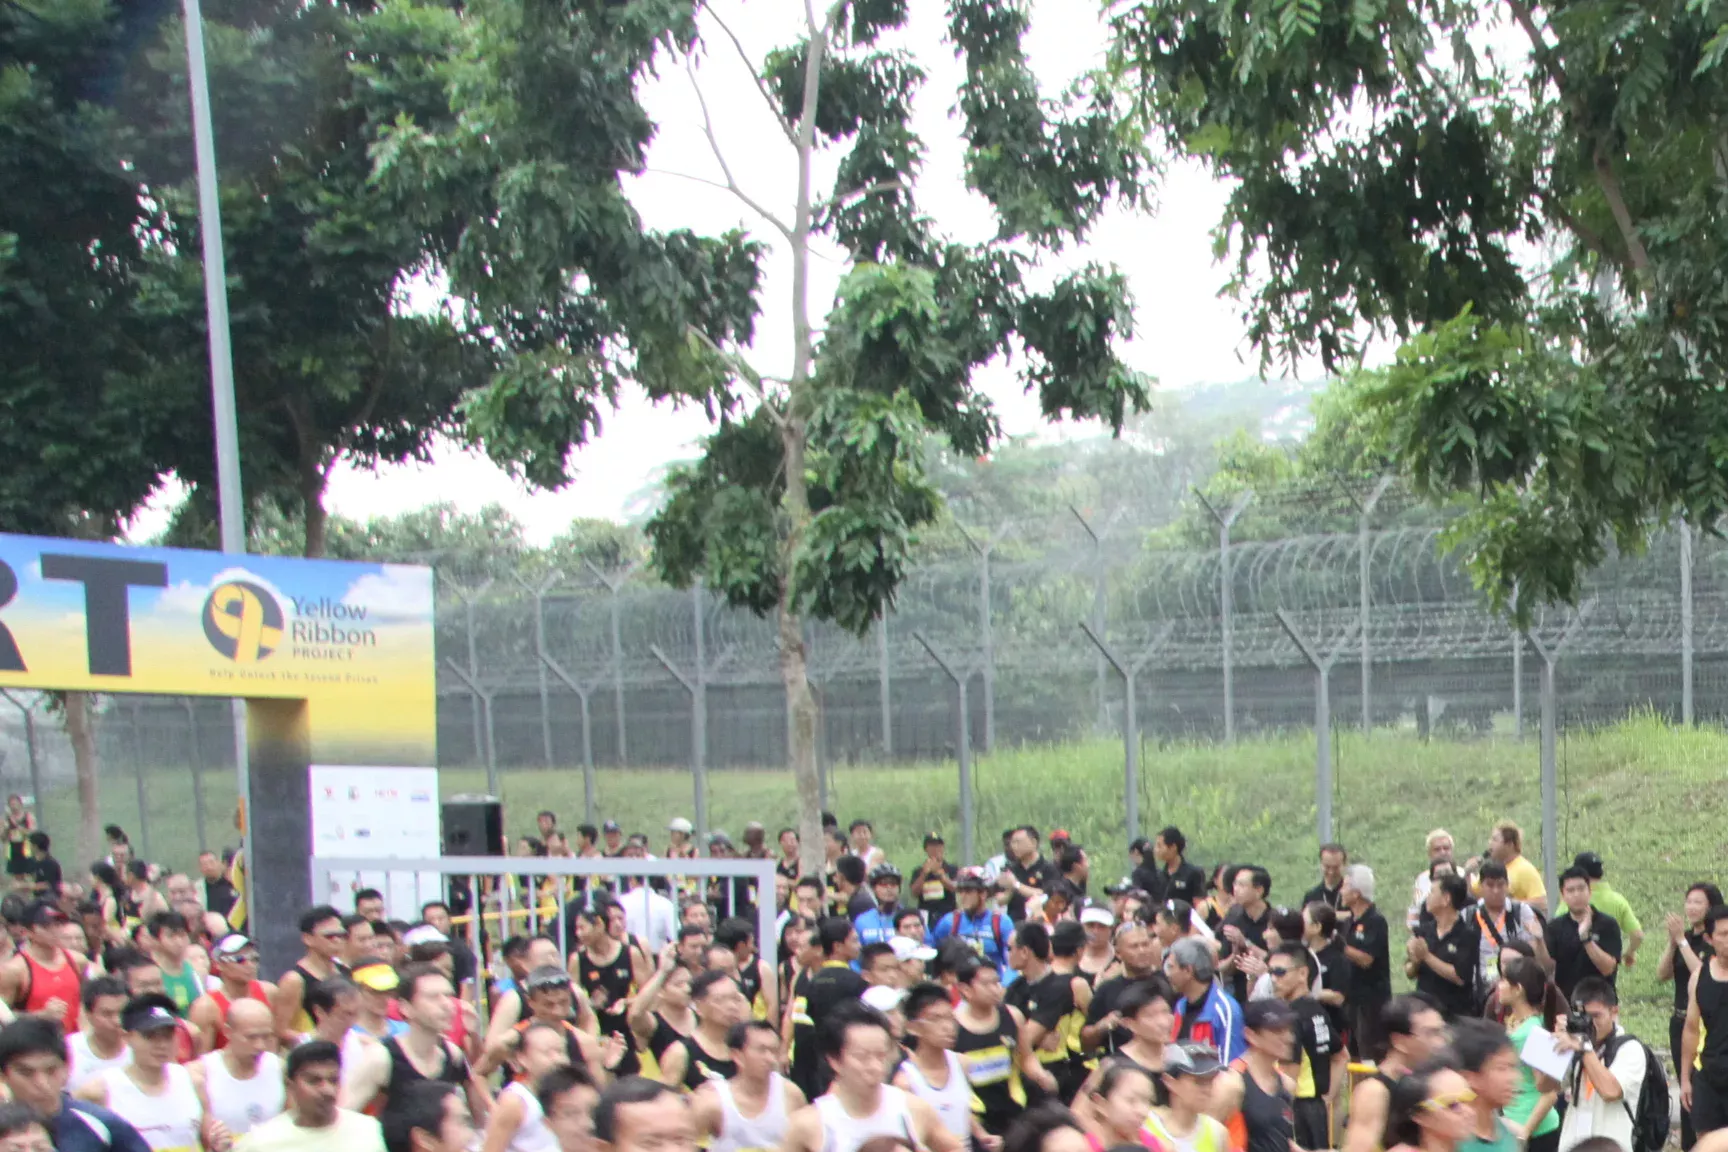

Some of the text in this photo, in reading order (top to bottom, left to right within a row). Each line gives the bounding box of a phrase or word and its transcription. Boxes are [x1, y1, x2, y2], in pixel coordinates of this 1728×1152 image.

[290, 596, 367, 621] Yellow
[292, 621, 377, 647] Ribbon
[292, 647, 355, 661] PROJECT
